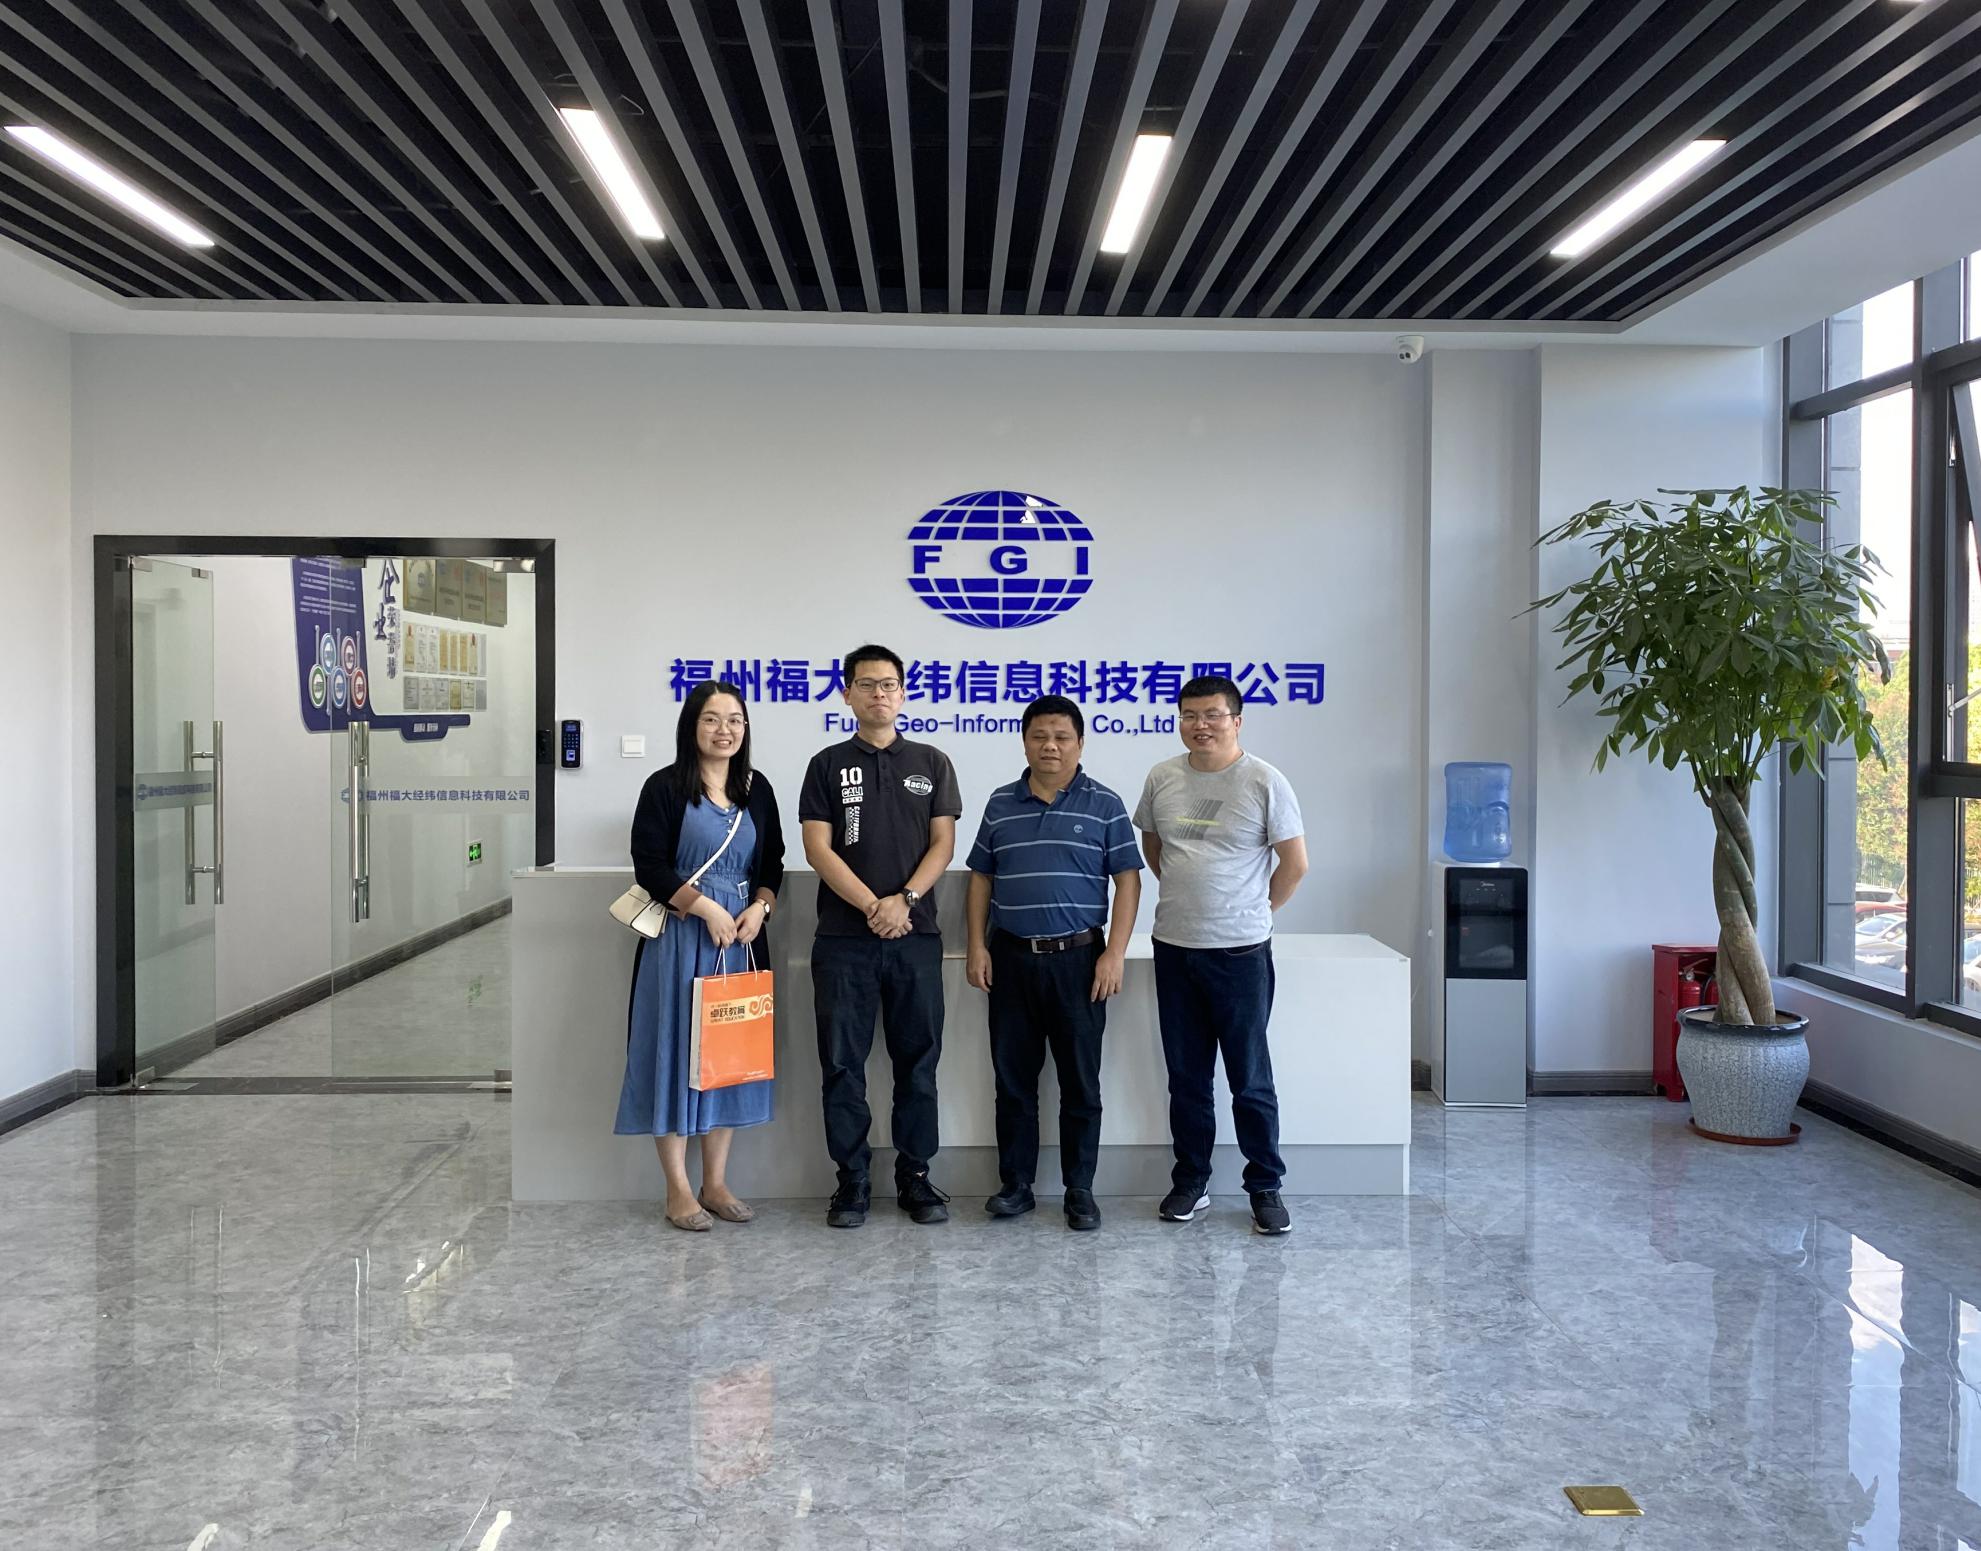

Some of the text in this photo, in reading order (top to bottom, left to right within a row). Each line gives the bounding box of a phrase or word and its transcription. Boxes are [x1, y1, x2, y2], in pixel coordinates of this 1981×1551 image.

[913, 545, 1089, 576] FGI
[670, 658, 1325, 706] 福州福大纬信息科技有公司
[894, 713, 1024, 733] Geo-Inform
[1092, 714, 1175, 736] Co.,Ltd
[840, 766, 863, 787] 10
[366, 790, 530, 801] 福州福大经纬信息科技有限公司
[841, 786, 863, 798] CALI
